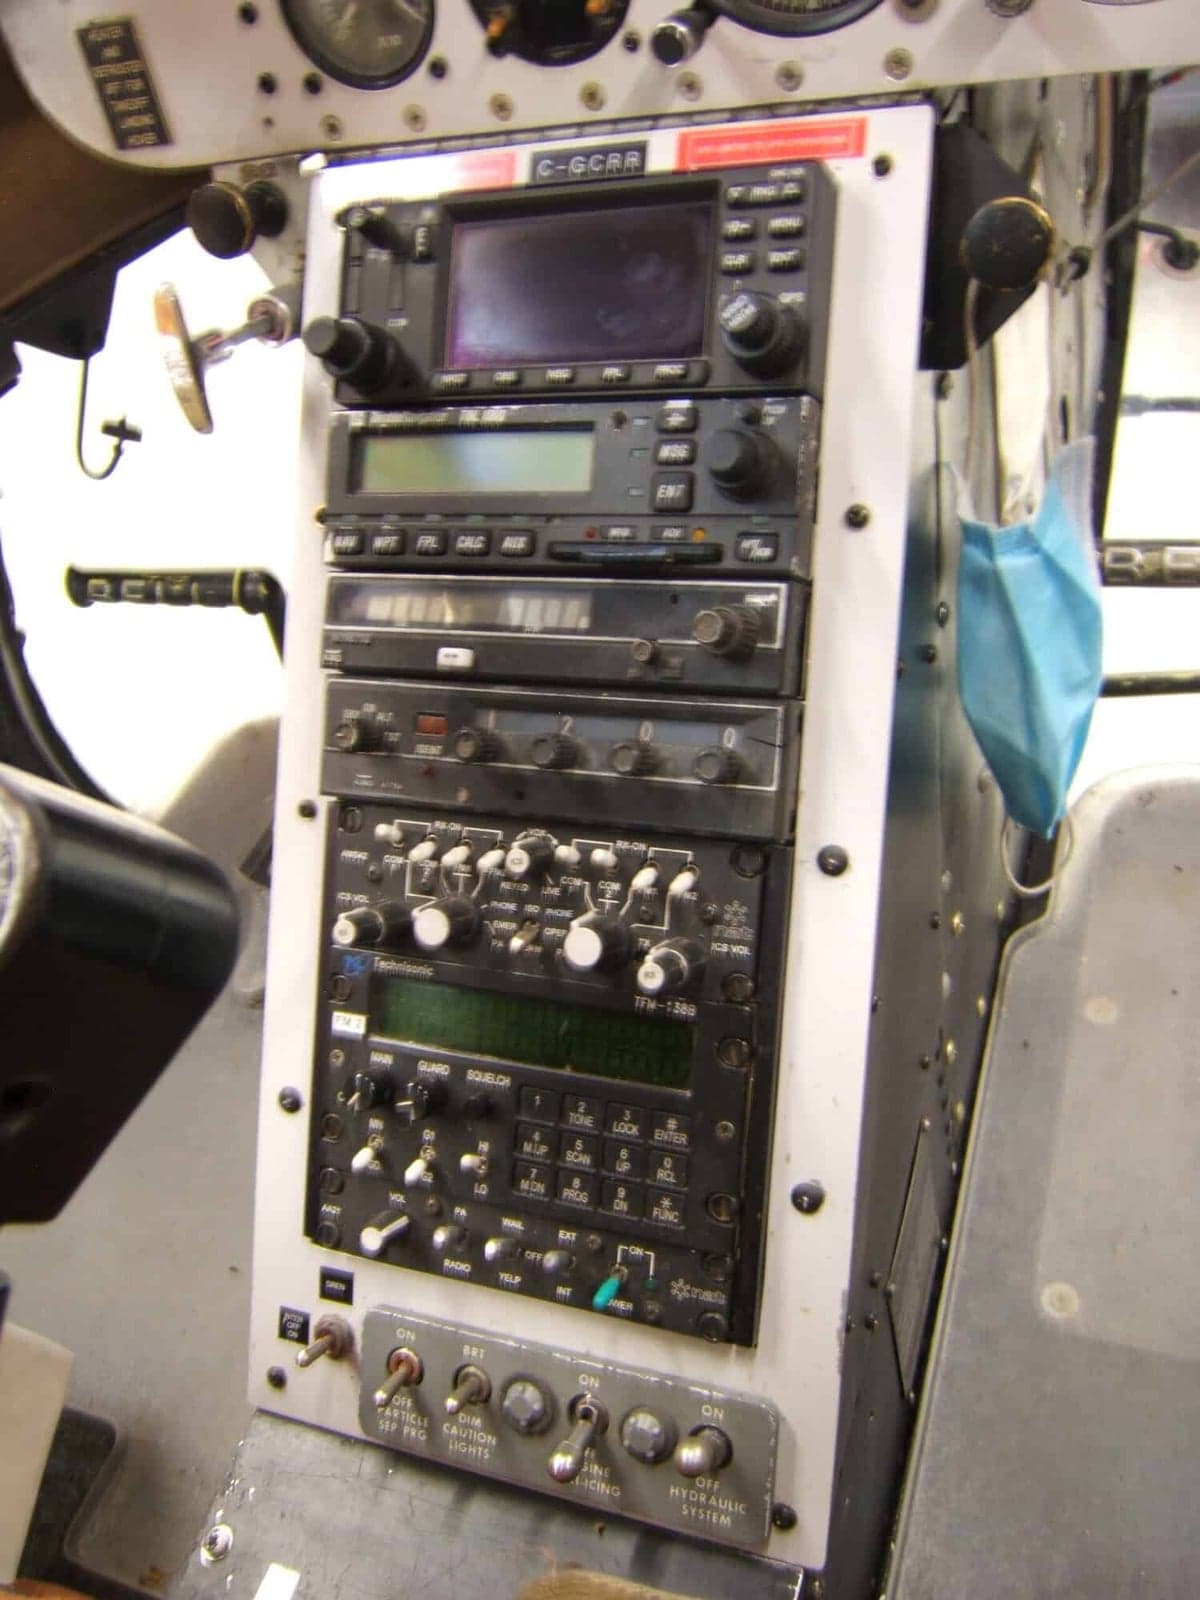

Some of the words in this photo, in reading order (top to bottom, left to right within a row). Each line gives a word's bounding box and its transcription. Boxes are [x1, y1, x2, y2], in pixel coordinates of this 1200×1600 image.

[536, 151, 642, 177] C-GCRR
[655, 484, 686, 499] ENT
[415, 535, 440, 549] FPL
[560, 714, 573, 737] 2
[721, 726, 737, 751] 0
[710, 942, 729, 954] ICS
[730, 945, 752, 957] VOL
[417, 1059, 449, 1075] GUARD
[466, 1068, 511, 1086] SQUELCH
[534, 1095, 541, 1105] 1
[577, 1101, 586, 1112] 2
[569, 1112, 595, 1127] TONE
[623, 1110, 630, 1120] 3
[613, 1121, 640, 1136] LOCK
[654, 1129, 688, 1144] ENTER
[575, 1139, 583, 1150] 5
[566, 1151, 592, 1166] SCAN
[620, 1148, 629, 1160] 6
[529, 1168, 537, 1179] 7
[616, 1160, 632, 1173] UP
[572, 1178, 580, 1190] 8
[656, 1169, 677, 1184] RCL
[389, 1192, 406, 1205] VOL
[562, 1189, 589, 1204] PROG
[617, 1188, 625, 1199] 9
[454, 1208, 467, 1218] PA
[613, 1200, 628, 1213] DN
[653, 1208, 679, 1223] FUNC
[559, 1230, 576, 1242] EXT
[525, 1251, 544, 1262] OFF
[629, 1247, 644, 1257] ON
[444, 1259, 471, 1274] RADIO
[499, 1271, 521, 1286] YELP
[557, 1286, 572, 1298] INT
[396, 1327, 416, 1341] ON
[464, 1344, 485, 1359] BRT
[578, 1374, 600, 1389] ON
[391, 1394, 413, 1409] OFF
[377, 1407, 428, 1429] PARTICLE
[458, 1413, 482, 1428] DIM
[701, 1405, 723, 1421] ON
[402, 1425, 427, 1442] PRG
[442, 1423, 497, 1447] CAUTION
[448, 1439, 490, 1460] LIGHTS
[695, 1476, 720, 1493] OFF
[669, 1485, 747, 1515] HYDRAULIC
[681, 1504, 731, 1526] SYSTEM
